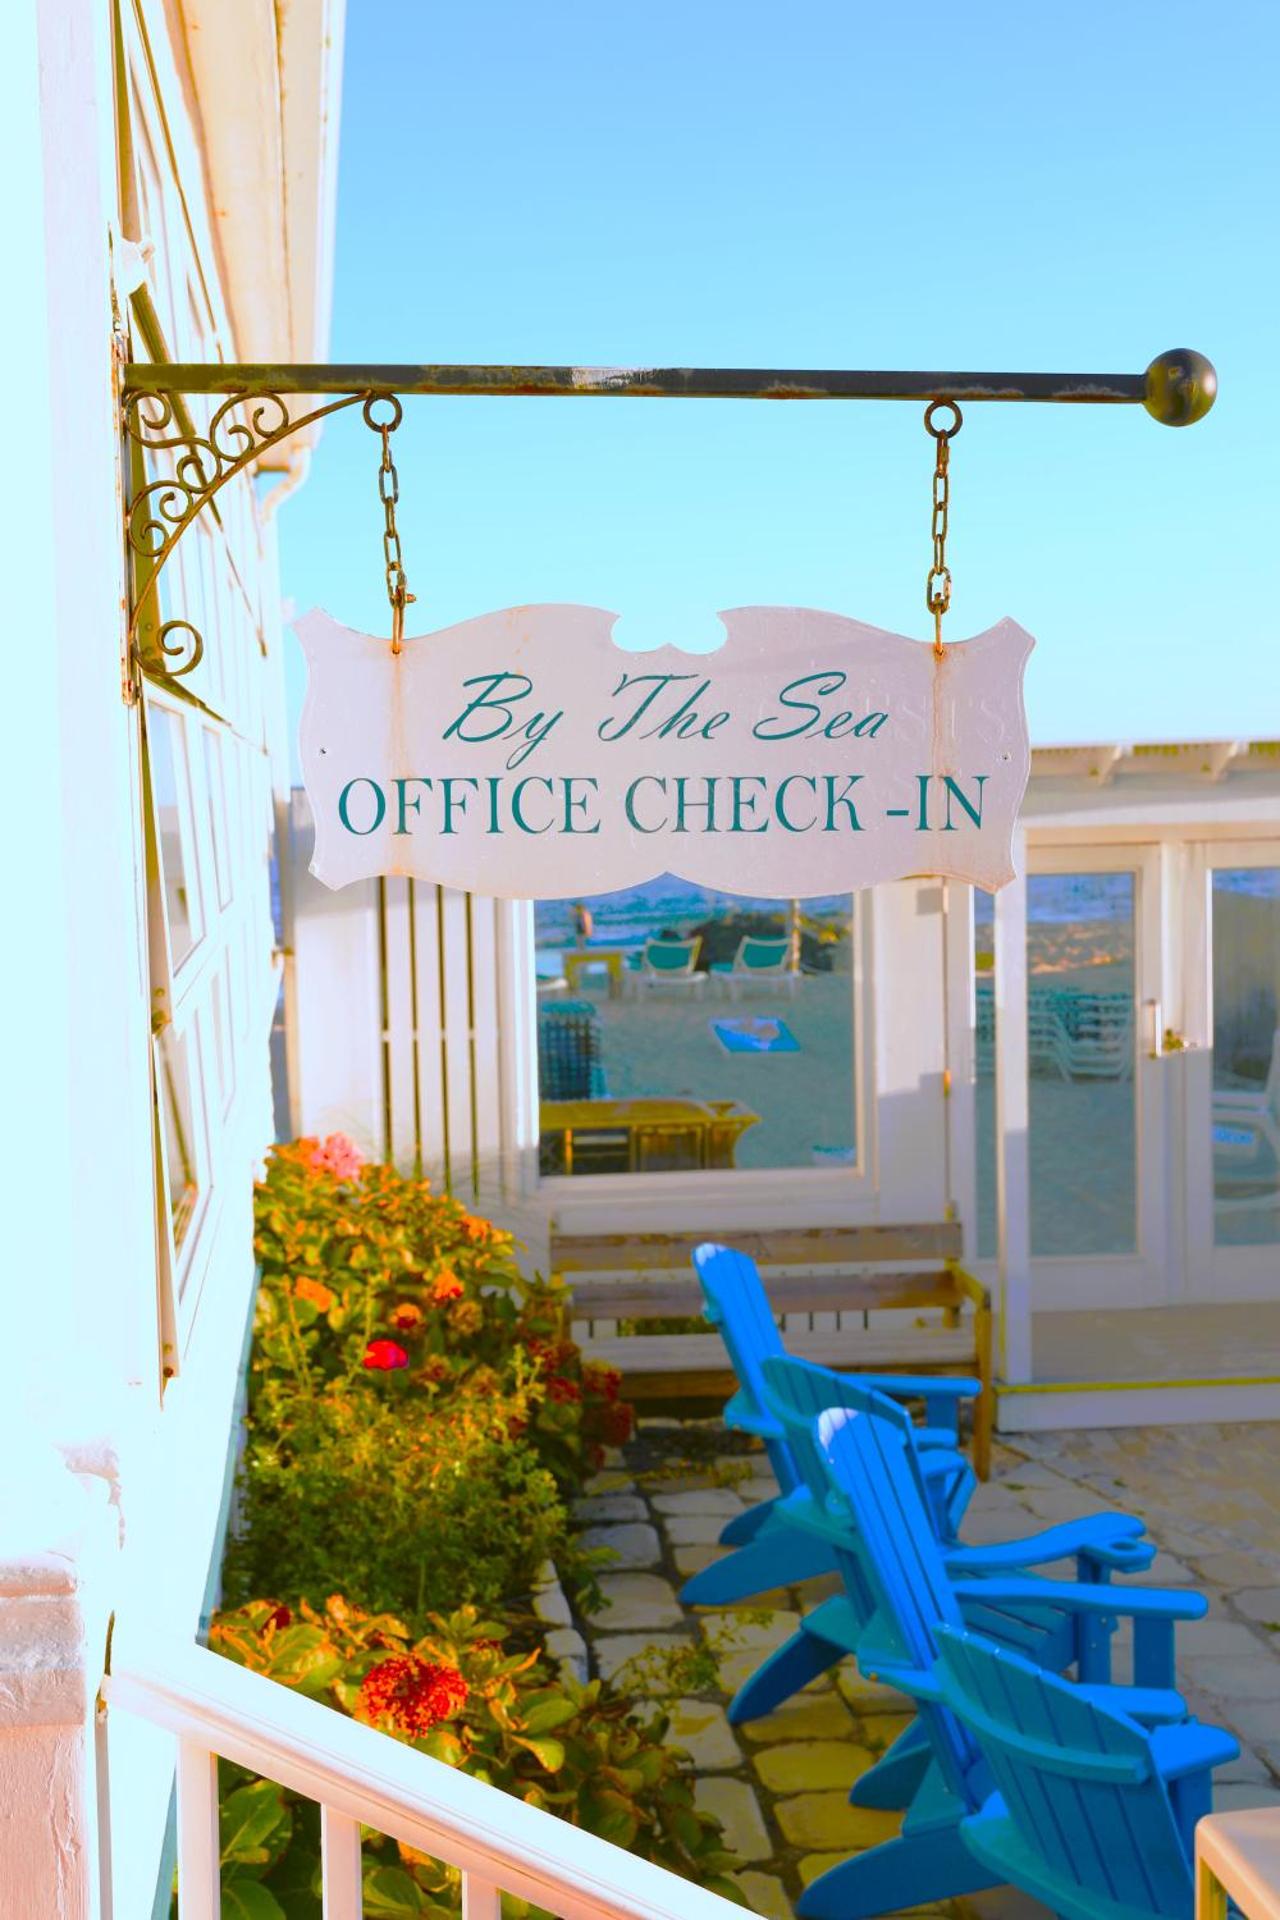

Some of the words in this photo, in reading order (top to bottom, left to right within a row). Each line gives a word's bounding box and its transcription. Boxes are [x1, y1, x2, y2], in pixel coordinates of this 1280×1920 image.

[441, 671, 564, 769] By
[598, 672, 731, 741] The
[752, 671, 889, 741] Sea
[338, 776, 601, 835] OFFICE
[625, 775, 865, 833] CHECK
